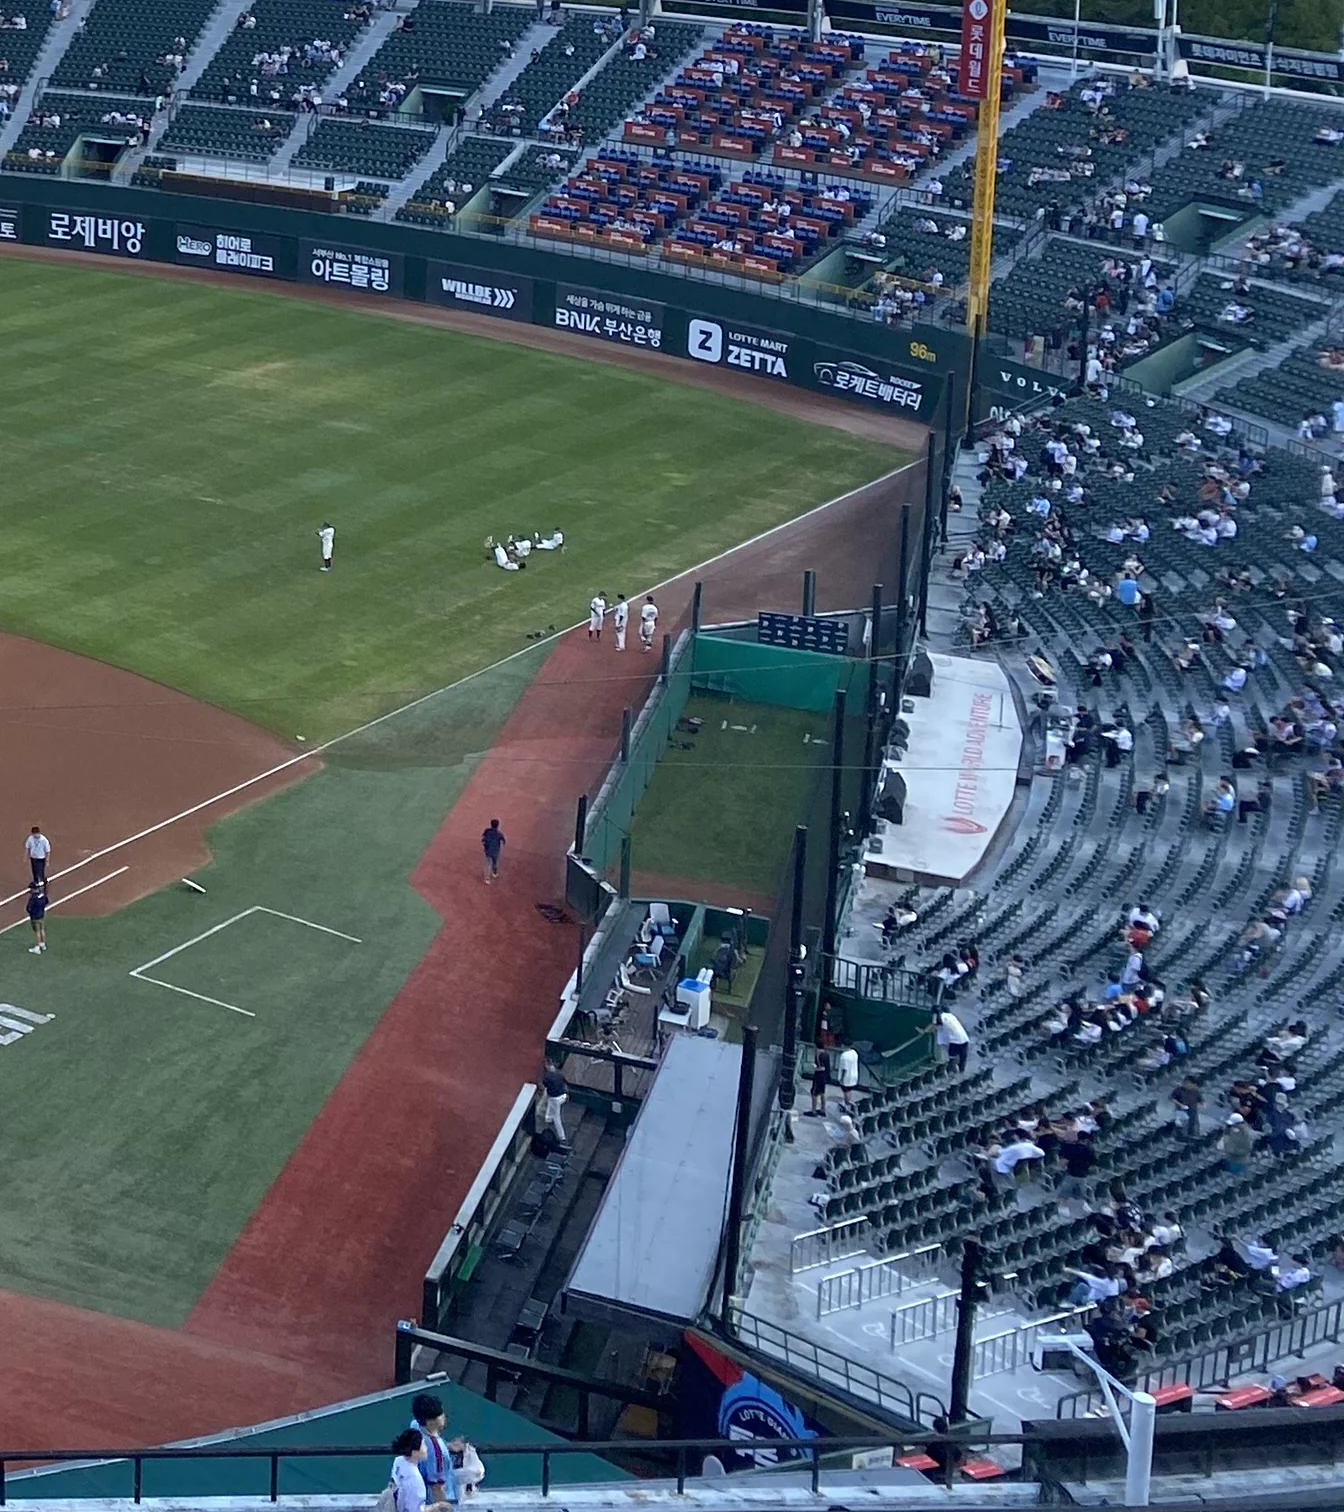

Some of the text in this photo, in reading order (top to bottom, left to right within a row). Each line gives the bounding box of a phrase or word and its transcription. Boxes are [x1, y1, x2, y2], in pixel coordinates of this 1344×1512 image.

[876, 12, 931, 27] EVERYTIME
[1048, 31, 1108, 49] EVERYTIME
[969, 24, 984, 94] 롯데월드
[48, 212, 146, 254] 로제비앙
[215, 234, 252, 253] 히어로
[177, 235, 212, 256] HERO
[312, 258, 390, 292] 아트몰링
[442, 278, 493, 299] WILLBE
[555, 307, 662, 348] BNK 부산은행
[698, 329, 713, 352] Z
[728, 331, 788, 354] LOTTE MART
[910, 341, 936, 363] 96m
[727, 345, 788, 378] ZETTA
[833, 371, 922, 411] 로케트배터리
[952, 782, 977, 816] LOTTE
[966, 692, 993, 746] ADVENTURE
[738, 1407, 766, 1423] LOTTE
